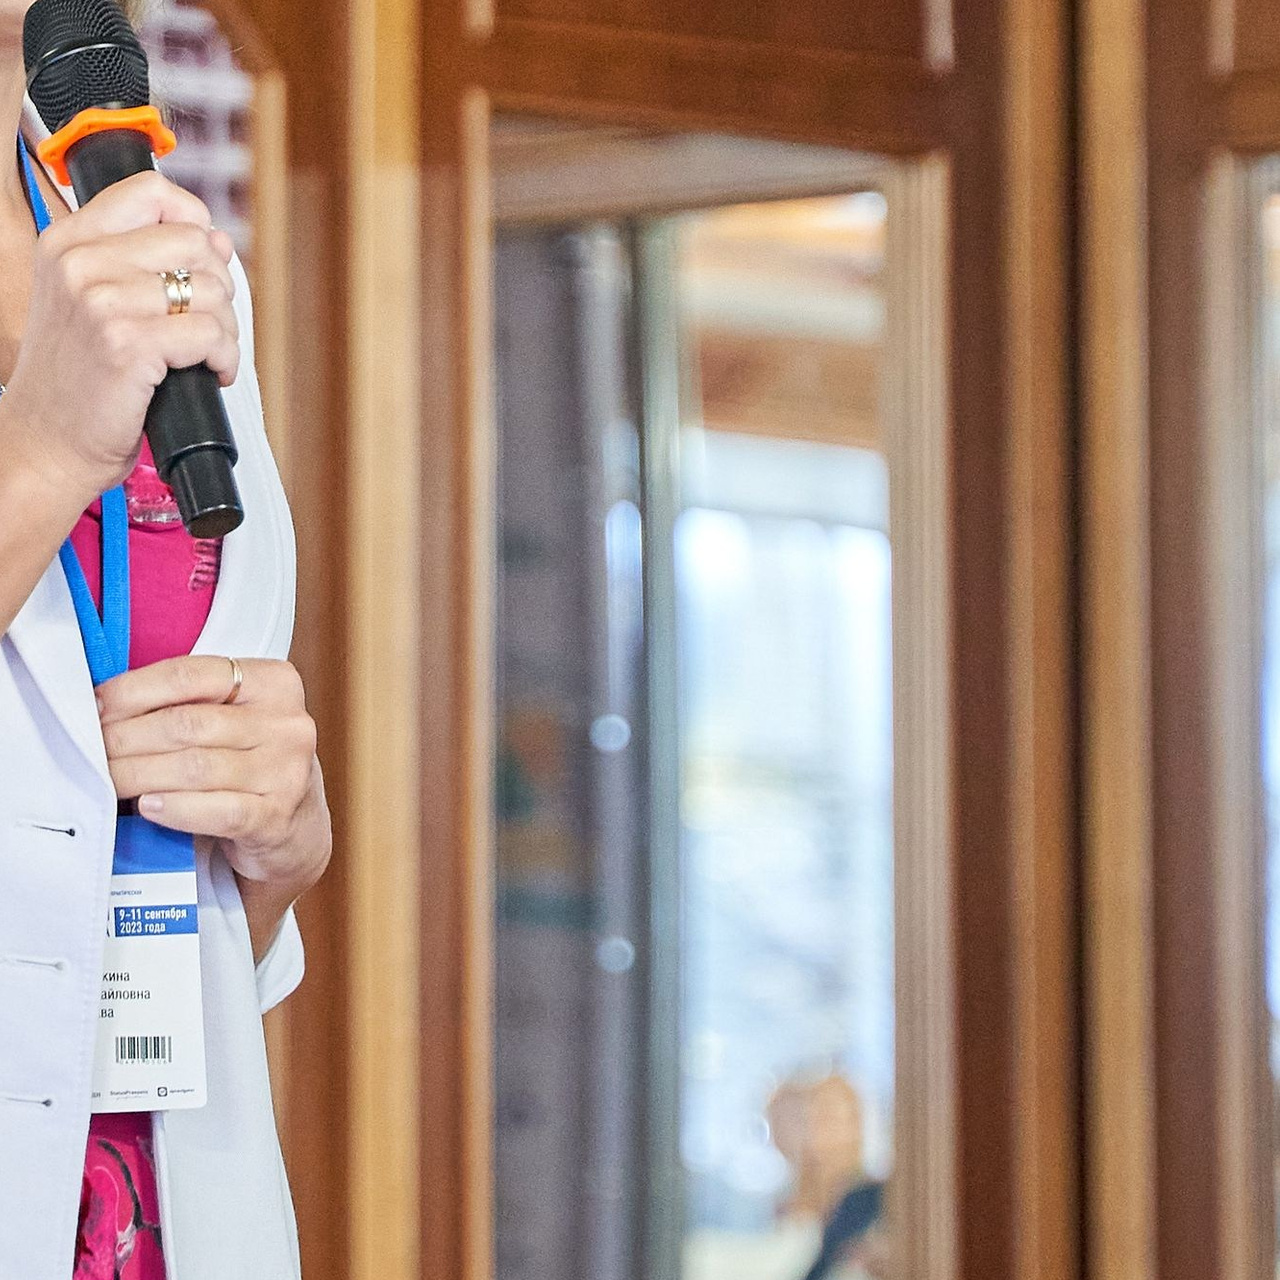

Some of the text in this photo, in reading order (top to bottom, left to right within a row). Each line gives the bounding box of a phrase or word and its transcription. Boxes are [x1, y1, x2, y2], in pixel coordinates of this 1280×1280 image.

[144, 907, 187, 921] сентября
[120, 921, 166, 933] 2023 года
[99, 1008, 114, 1019] ва
